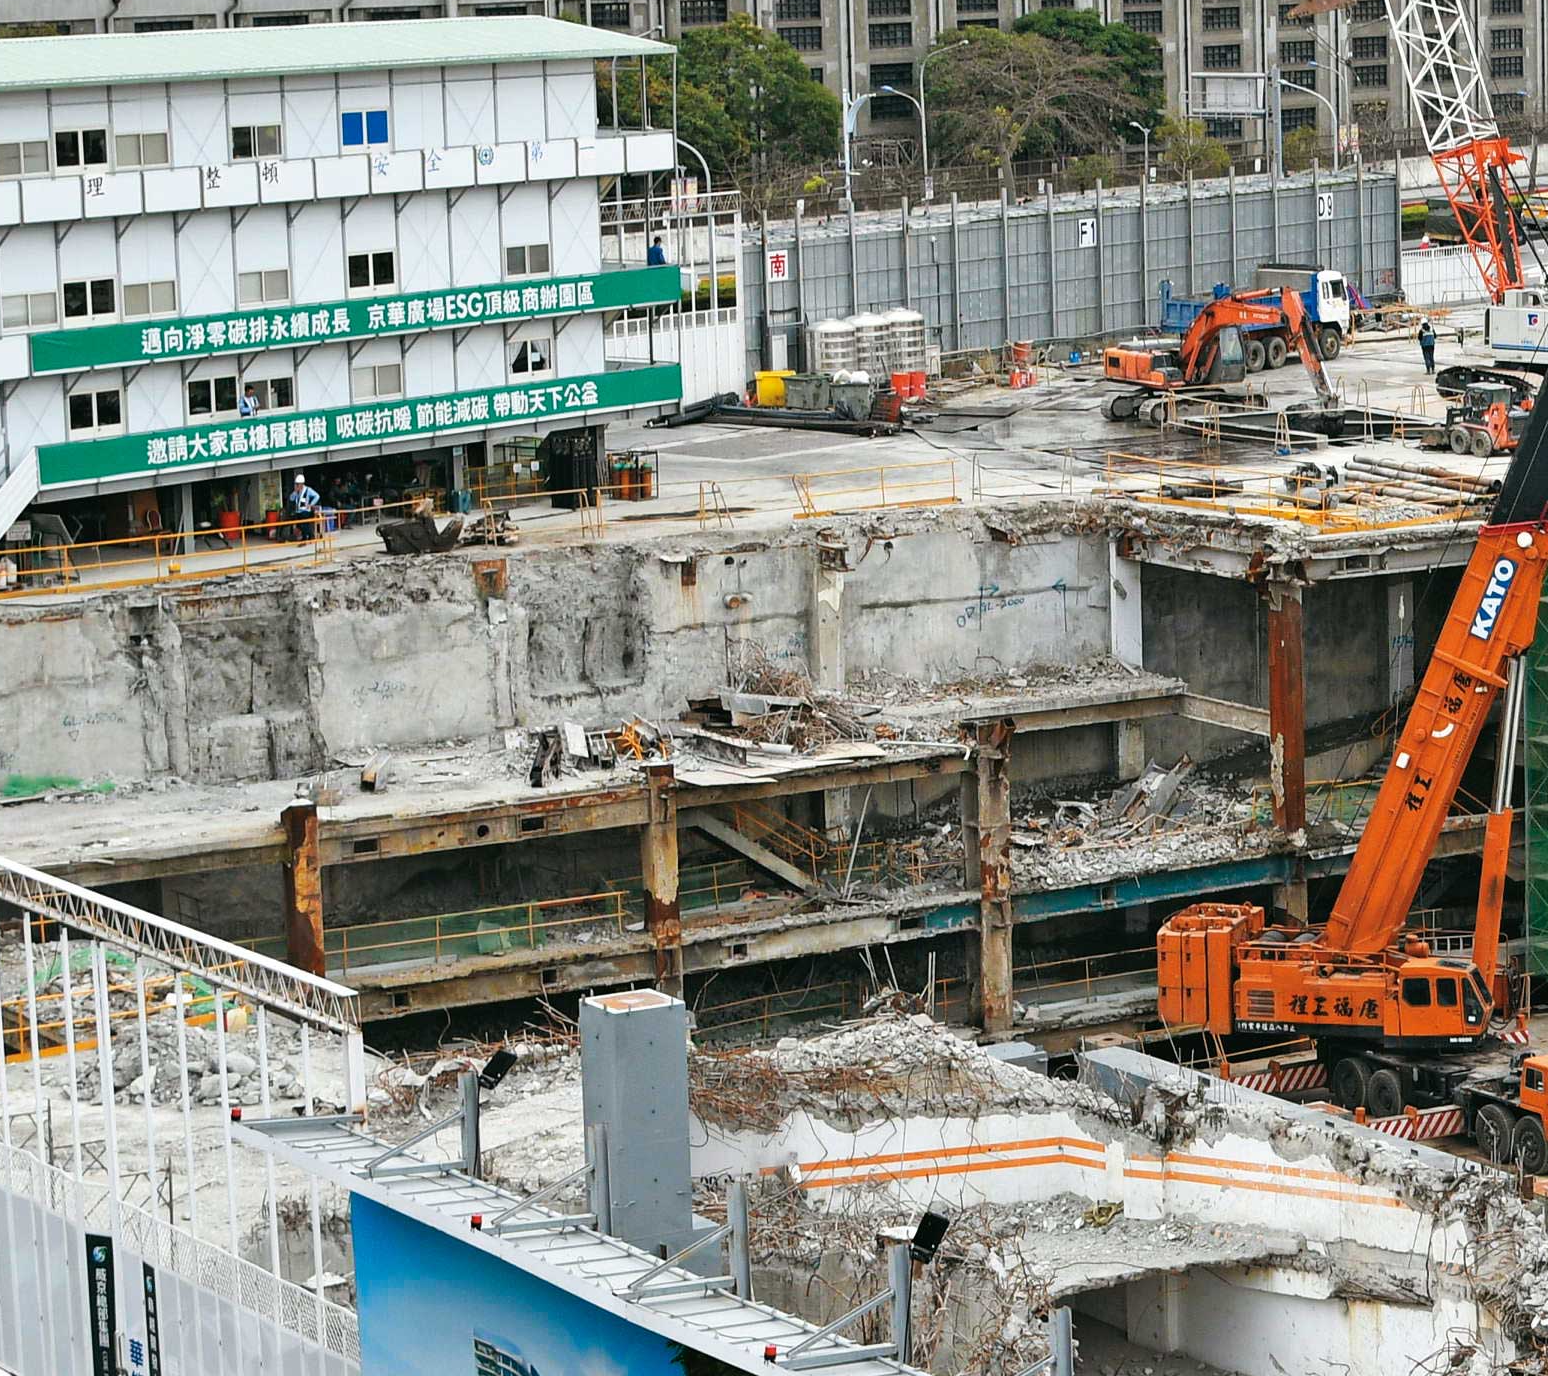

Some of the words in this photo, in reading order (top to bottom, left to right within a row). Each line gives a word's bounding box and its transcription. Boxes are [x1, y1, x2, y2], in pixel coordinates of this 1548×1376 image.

[85, 177, 105, 197] 理
[205, 163, 280, 191] 整頓
[373, 151, 442, 177] 安全
[1317, 194, 1334, 220] D9
[1078, 220, 1096, 247] F1
[768, 250, 789, 281] 南
[141, 307, 352, 356] 邁向淨零碳排永續成長
[367, 281, 596, 330] 京華廣場ESG頂級商辦園區
[146, 417, 328, 466] 邀請大家高樓層種樹
[336, 406, 413, 439] 吸碳抗暖
[416, 396, 489, 427] 節能減碳
[493, 381, 599, 417] 帶動天下公益
[1471, 558, 1517, 641] KATO
